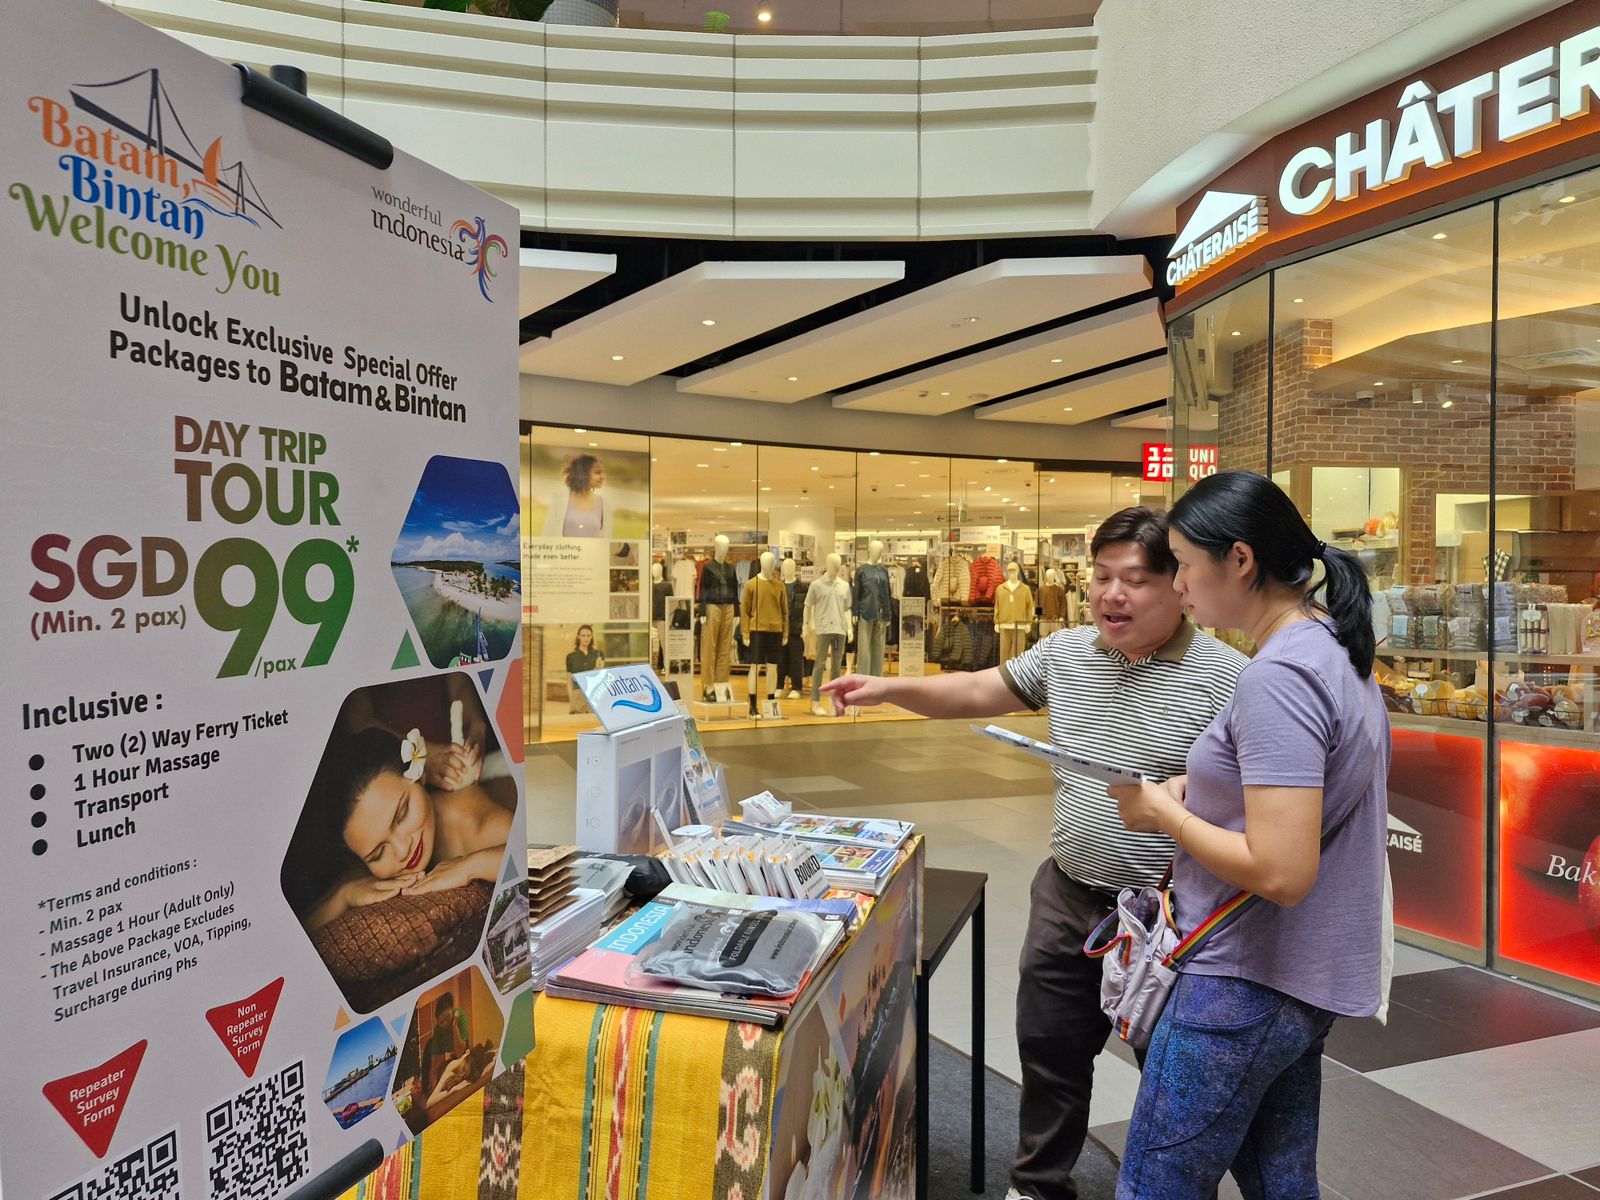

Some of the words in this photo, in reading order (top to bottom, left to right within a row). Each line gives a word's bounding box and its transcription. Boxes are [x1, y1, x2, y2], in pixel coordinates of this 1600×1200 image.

[1279, 26, 1600, 216] CHÂTER
[28, 95, 190, 198] Batam,
[59, 155, 204, 239] Bintan
[371, 186, 442, 227] wonderful
[8, 183, 209, 276] Welcome
[215, 244, 281, 296] You
[371, 208, 465, 262] indonesia
[1166, 196, 1261, 287] CHÂTERAISÉ
[109, 330, 240, 386] Packages
[246, 360, 271, 386] to
[120, 292, 218, 341] Unlock
[227, 317, 334, 365] Exclusive
[344, 345, 410, 382] Special
[416, 362, 458, 392] Offer
[174, 415, 250, 458] DAY
[258, 427, 327, 465] TRIP
[1190, 449, 1215, 463] UNI
[1189, 464, 1217, 480] QLO
[174, 458, 341, 527] TOUR
[29, 533, 189, 603] SGD
[31, 611, 101, 640] (Min.
[112, 608, 126, 629] 2
[135, 604, 187, 633] pax)
[254, 656, 297, 679] /pax
[22, 691, 148, 730] Inclusive
[72, 742, 114, 763] Two
[120, 730, 147, 758] (2)
[152, 727, 191, 749] Way
[196, 719, 239, 741] Ferry
[242, 709, 289, 732] Ticket
[75, 773, 86, 791] 1
[92, 765, 140, 788] Hour
[146, 748, 220, 777] Massage
[74, 782, 169, 819] Transport
[76, 816, 136, 848] Lunch
[1386, 833, 1423, 853] AISÉ
[95, 878, 121, 898] and
[124, 858, 191, 889] conditions
[794, 854, 821, 885] BOOKED
[1545, 854, 1600, 886] Bak
[49, 915, 82, 935] Min.
[86, 908, 95, 922] 2
[99, 902, 123, 924] pax
[50, 927, 113, 957] Massage
[116, 921, 125, 933] 1
[128, 909, 160, 930] Hour
[163, 894, 201, 920] (Adult
[204, 881, 235, 903] Only)
[607, 905, 669, 951] INDONESIA
[50, 960, 78, 980] The
[81, 942, 124, 968] Above
[128, 925, 181, 952] Package
[184, 903, 235, 930] Excludes
[52, 971, 98, 1001] Travel
[102, 948, 171, 982] Insurance,
[174, 935, 204, 953] VOA,
[206, 917, 251, 943] Tipping,
[54, 985, 127, 1022] Surcharge
[131, 966, 173, 992] during
[176, 956, 198, 974] Phs
[226, 1010, 268, 1036] Repeater
[237, 1002, 256, 1018] Non
[231, 1025, 263, 1047] Survey
[236, 1038, 261, 1058] Form
[69, 1067, 126, 1103] Repeater
[76, 1086, 120, 1115] Survey
[83, 1102, 115, 1127] Form
